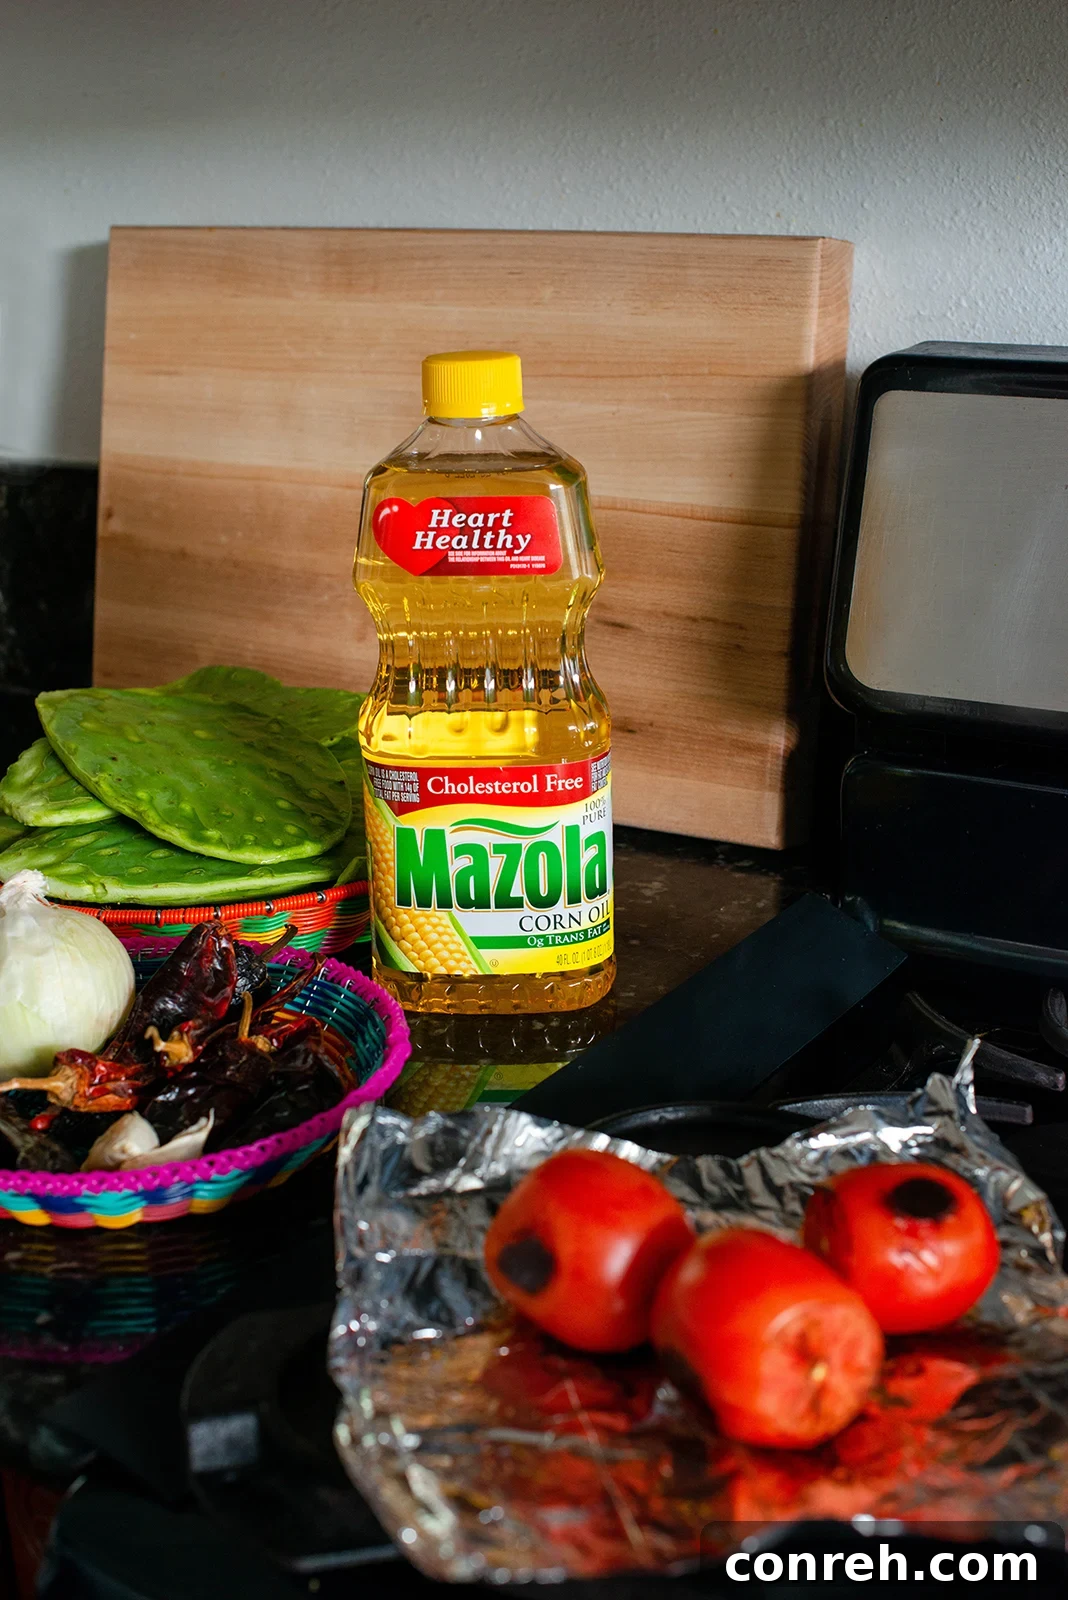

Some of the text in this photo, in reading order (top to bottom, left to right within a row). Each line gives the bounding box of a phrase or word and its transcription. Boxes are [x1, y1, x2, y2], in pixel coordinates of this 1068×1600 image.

[428, 508, 514, 528] Heart
[412, 529, 531, 554] Healthy
[389, 769, 419, 782] CHOLESTEROL
[426, 774, 539, 794] Cholesterol
[545, 773, 584, 793] Free
[585, 796, 606, 813] 100%
[582, 807, 606, 825] PURE
[393, 824, 609, 913] Mazola
[518, 911, 582, 932] CORN
[588, 899, 610, 923] OIL
[546, 931, 585, 945] TRANS
[587, 925, 602, 939] FAT
